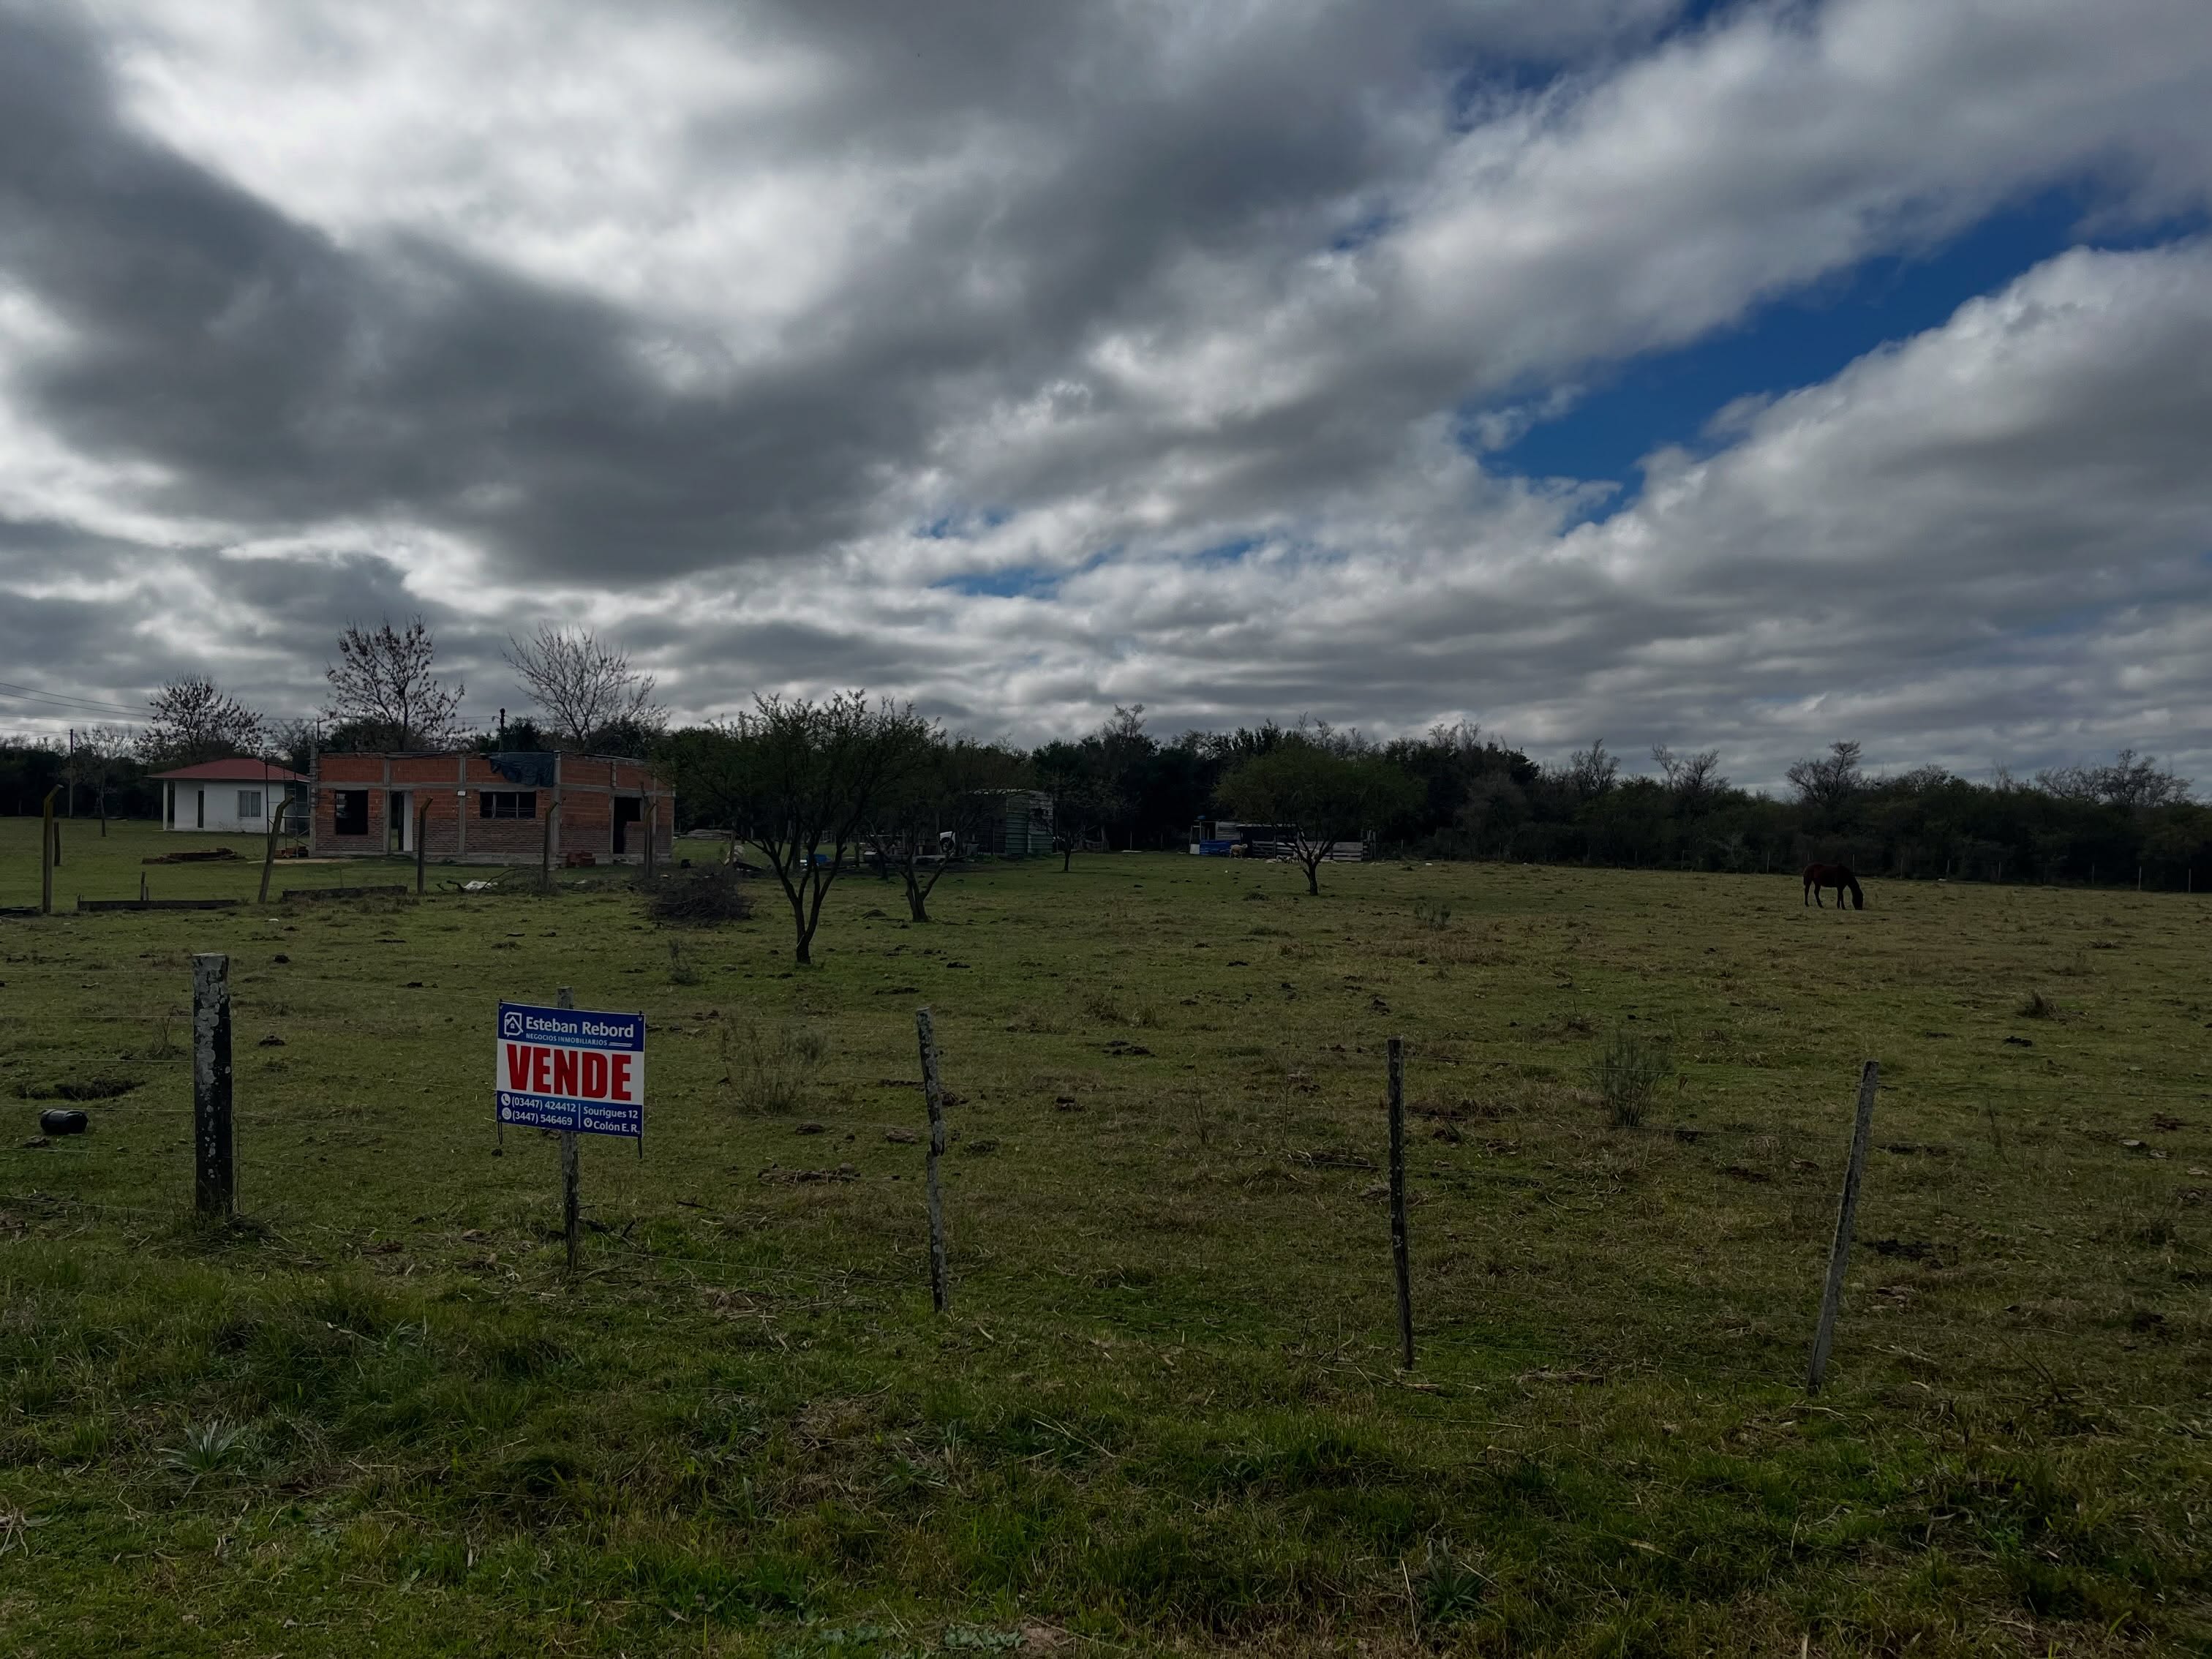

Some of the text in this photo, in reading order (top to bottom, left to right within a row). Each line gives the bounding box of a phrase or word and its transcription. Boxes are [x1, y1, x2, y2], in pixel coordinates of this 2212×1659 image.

[526, 1017, 633, 1037] Esteban Rebord
[526, 1034, 607, 1046] NEGOCIOS INMOBILIARIOS
[507, 1044, 631, 1101] VENDE
[512, 1096, 576, 1112] (03447) 424412
[513, 1110, 573, 1125] (3447) 546469
[584, 1107, 638, 1118] Sourigues 12
[594, 1121, 620, 1130] Colón
